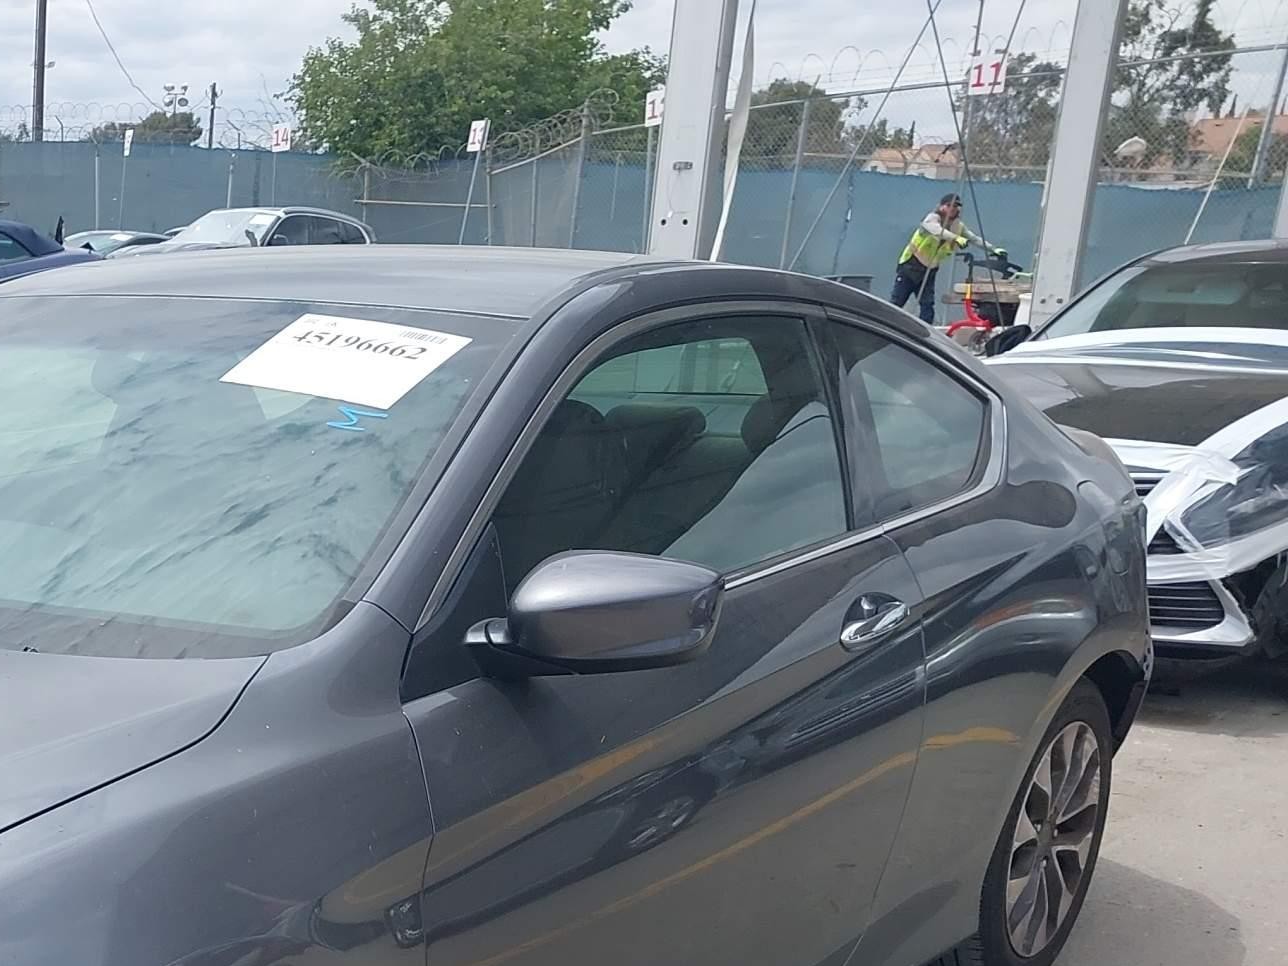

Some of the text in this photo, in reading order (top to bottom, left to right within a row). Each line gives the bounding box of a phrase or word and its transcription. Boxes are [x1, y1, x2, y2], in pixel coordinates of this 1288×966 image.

[971, 62, 1001, 88] 11
[273, 127, 289, 147] 14
[292, 329, 429, 361] 45196662
